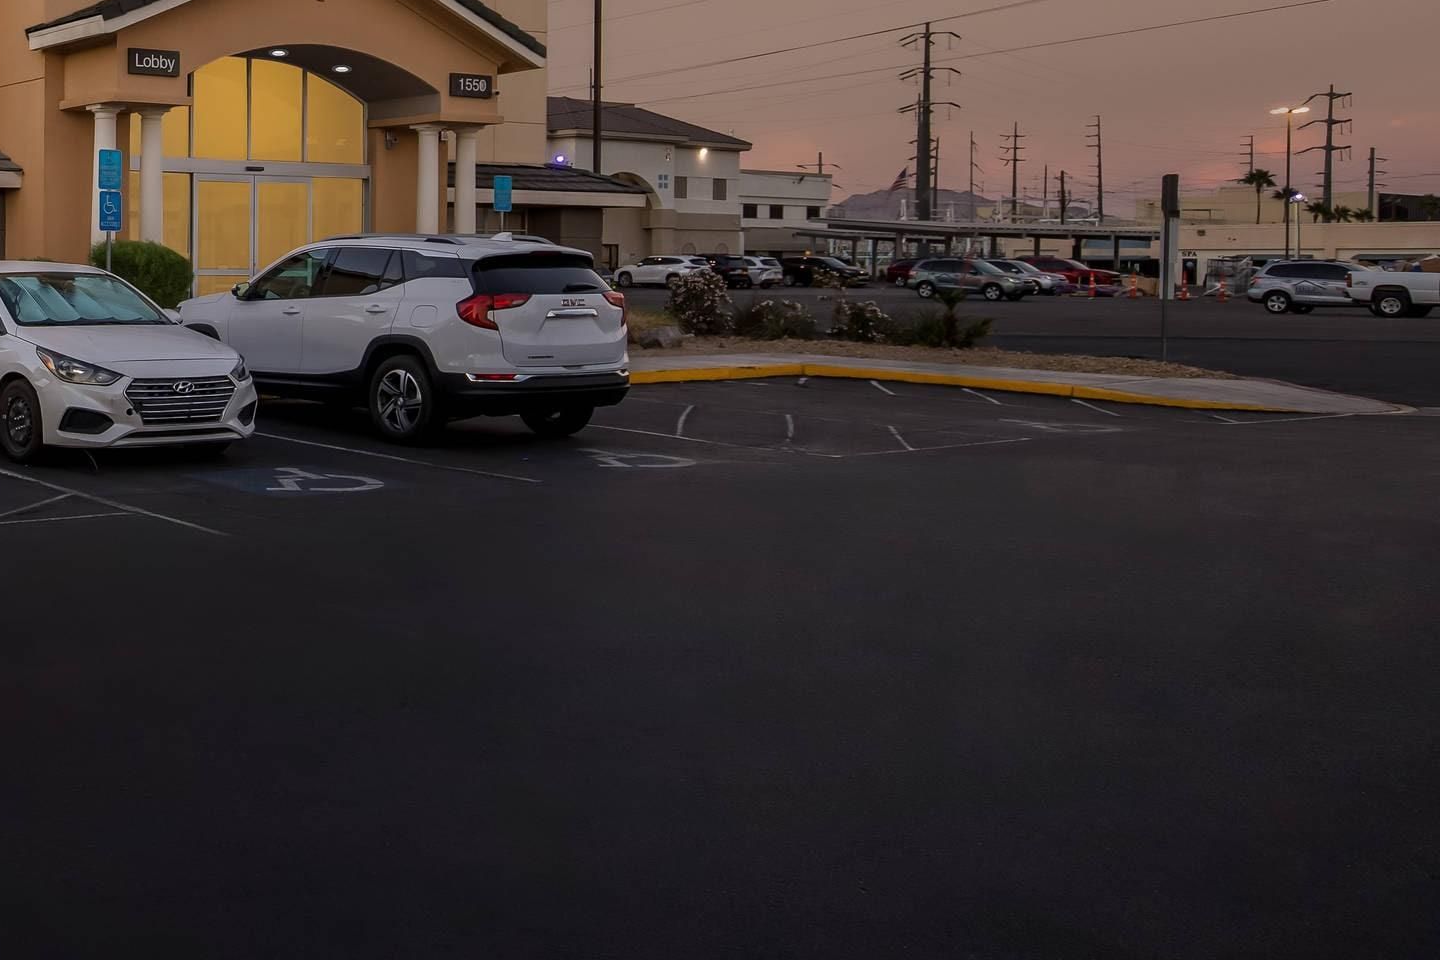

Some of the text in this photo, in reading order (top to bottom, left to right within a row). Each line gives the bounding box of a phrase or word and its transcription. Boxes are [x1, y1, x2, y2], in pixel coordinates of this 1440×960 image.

[135, 53, 175, 72] Lobby
[459, 78, 487, 92] 1550
[561, 298, 586, 307] GMC
